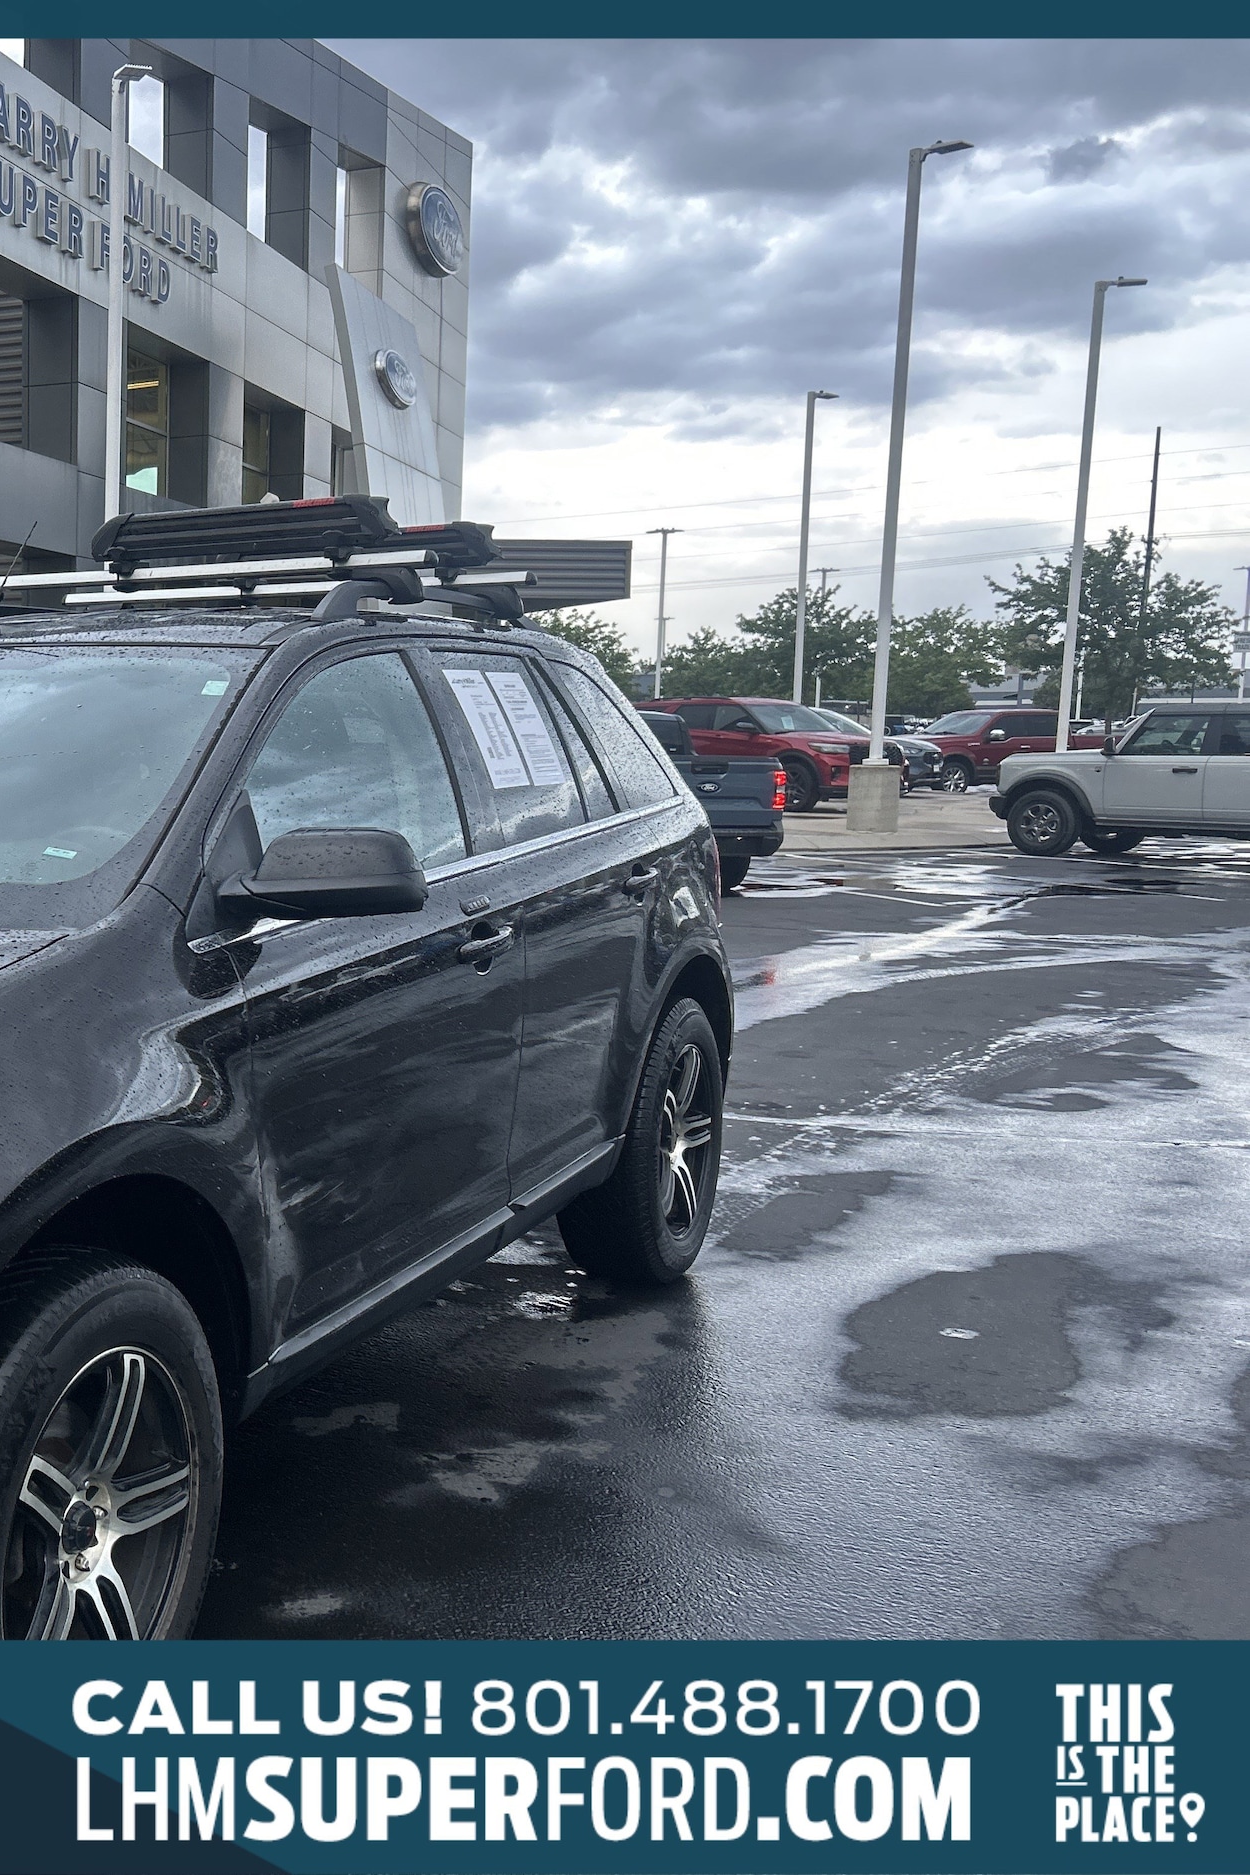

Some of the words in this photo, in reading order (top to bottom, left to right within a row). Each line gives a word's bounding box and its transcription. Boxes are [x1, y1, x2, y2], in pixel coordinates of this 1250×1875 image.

[89, 148, 111, 205] H
[124, 170, 219, 274] MILLER
[93, 221, 171, 305] FORD
